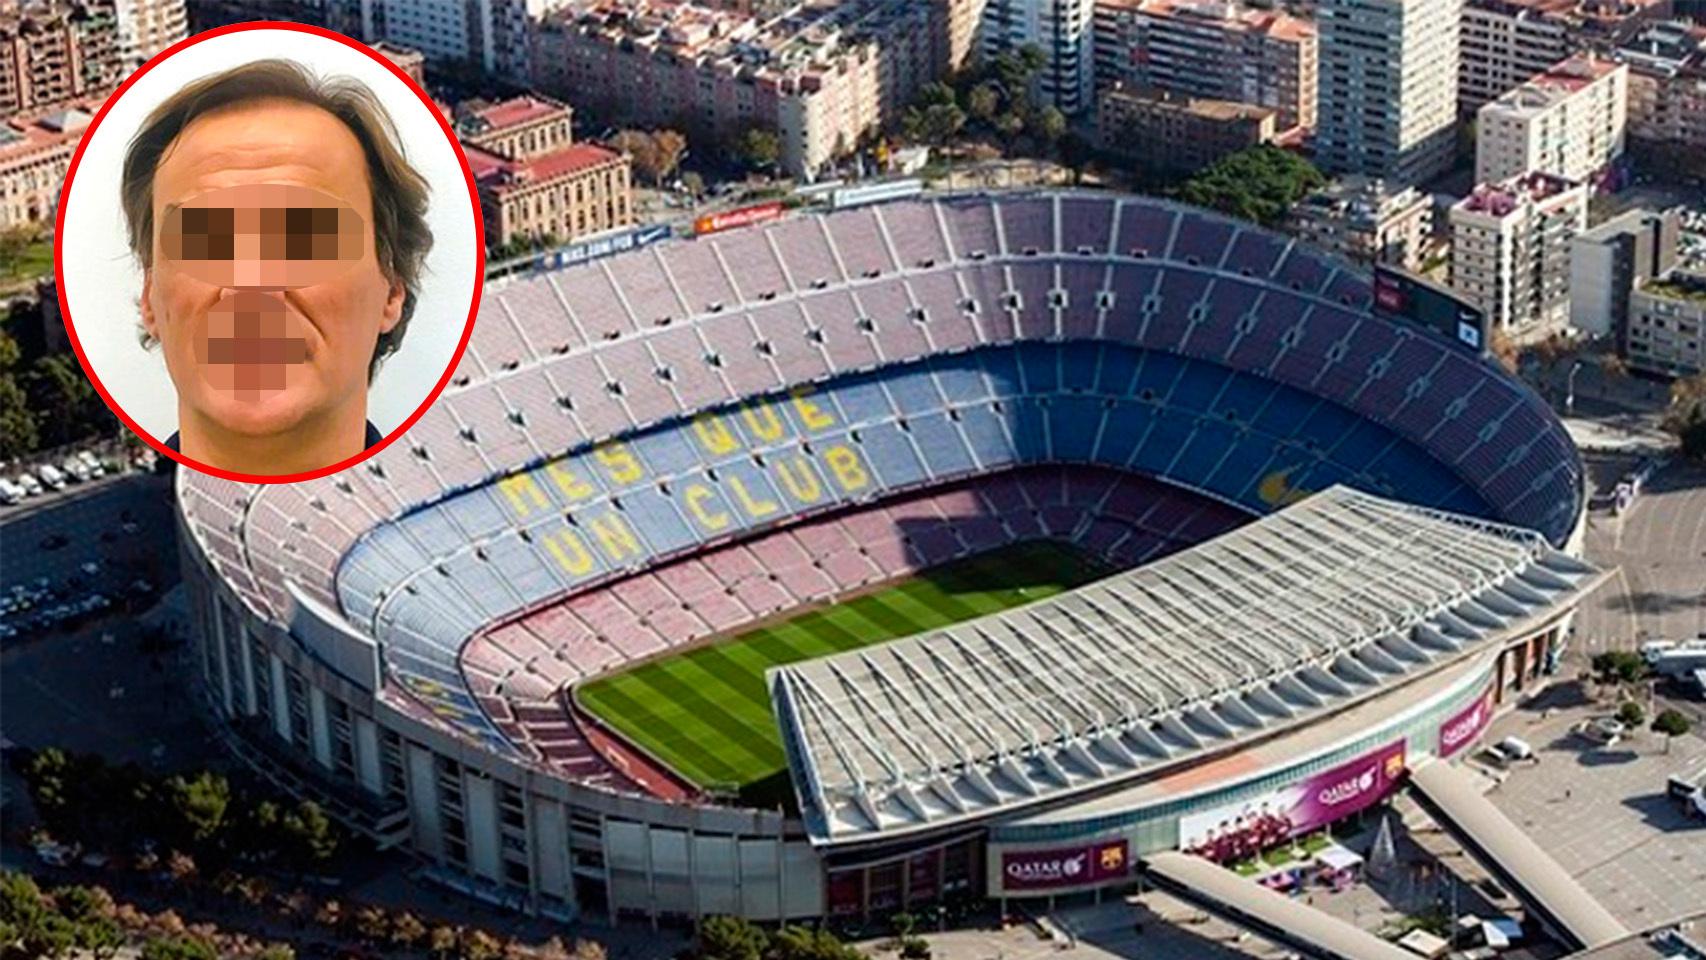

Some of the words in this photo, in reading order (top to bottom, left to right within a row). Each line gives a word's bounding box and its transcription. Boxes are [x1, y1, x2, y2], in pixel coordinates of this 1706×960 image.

[543, 512, 643, 576] UN
[684, 445, 869, 530] CLUB
[1007, 861, 1061, 876] QATAR
